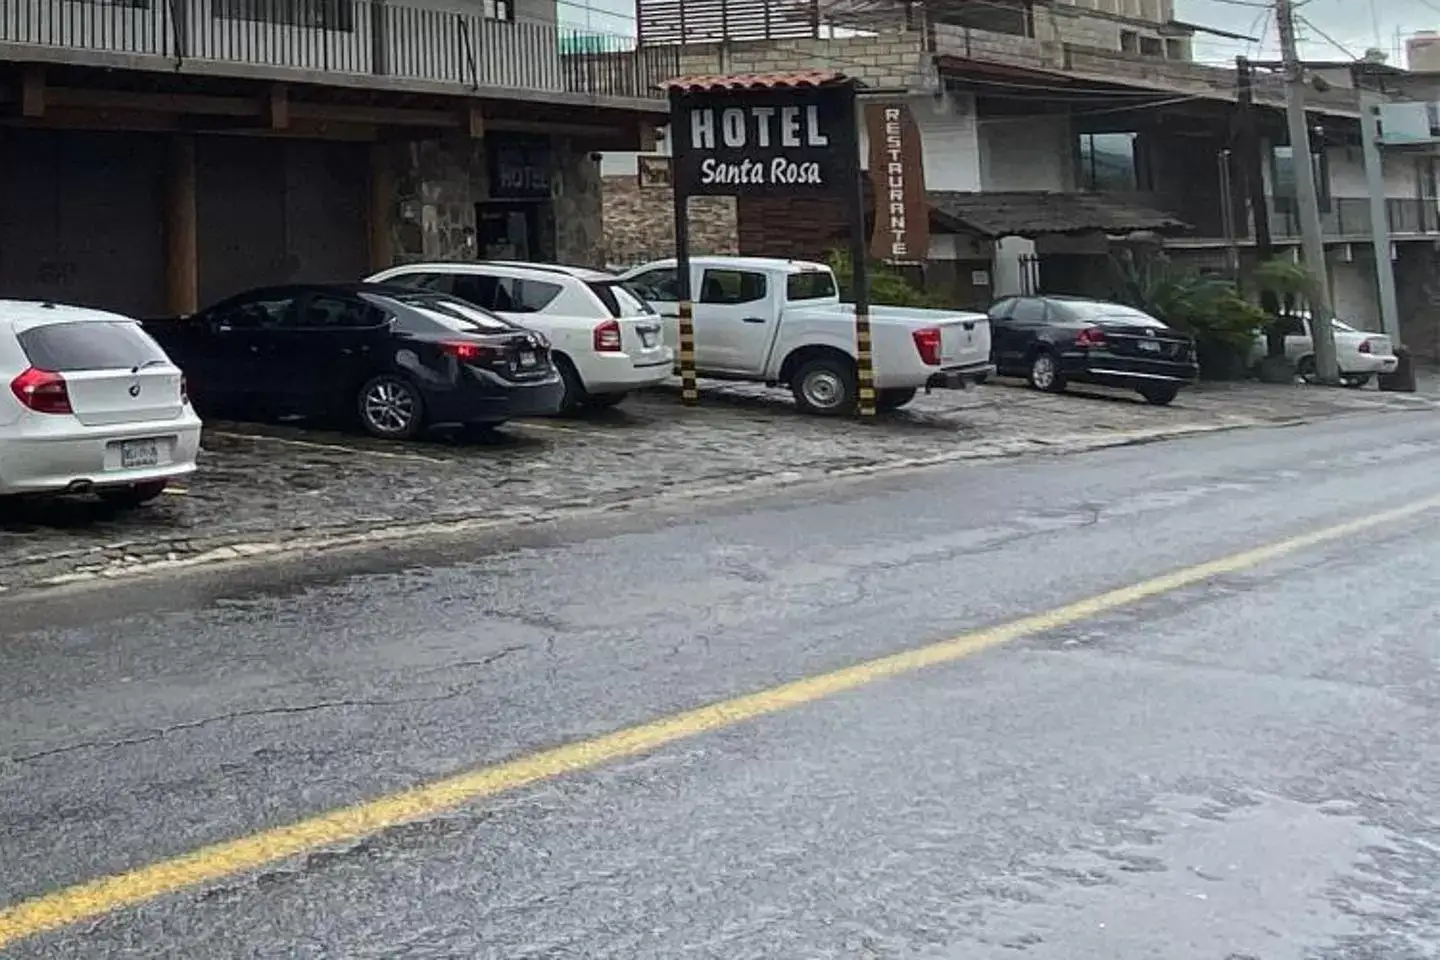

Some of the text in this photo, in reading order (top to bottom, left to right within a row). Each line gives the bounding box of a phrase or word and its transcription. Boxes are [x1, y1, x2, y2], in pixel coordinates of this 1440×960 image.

[690, 104, 828, 149] HOTEL
[500, 165, 548, 189] HOTEL
[701, 156, 823, 185] Santa Rosa
[884, 107, 908, 256] RESTAURANTE
